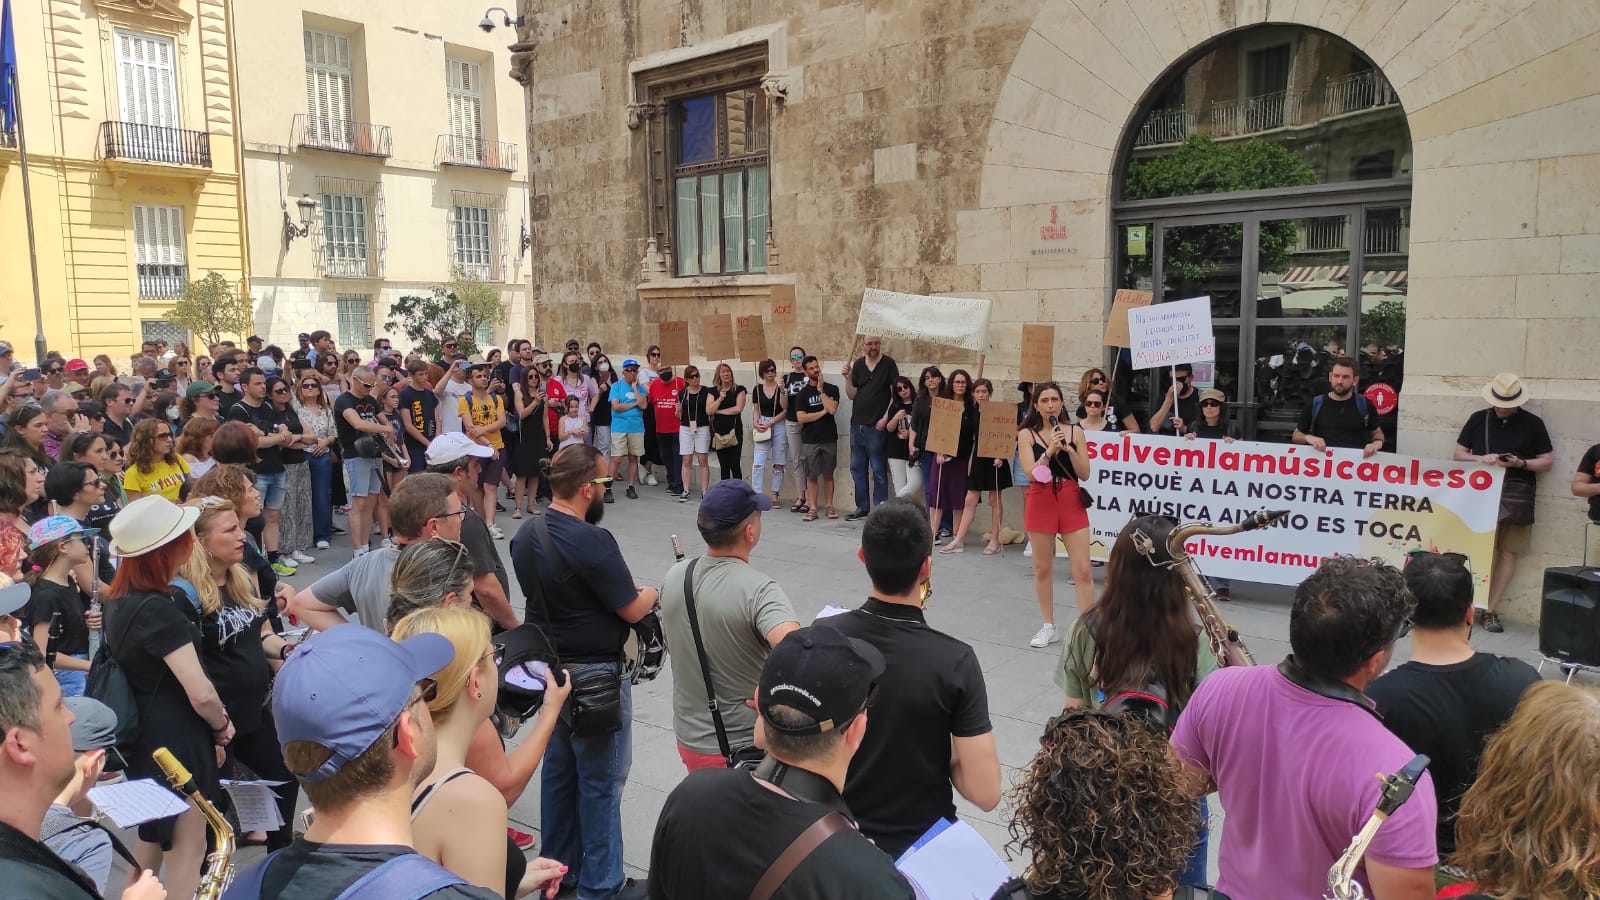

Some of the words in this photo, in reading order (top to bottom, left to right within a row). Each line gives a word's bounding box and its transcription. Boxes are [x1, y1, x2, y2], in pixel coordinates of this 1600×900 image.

[1098, 470, 1183, 491] PERQUÈ
[1189, 477, 1204, 493] A
[1212, 479, 1239, 497] LA
[1248, 482, 1344, 506] NOSTRA
[1354, 490, 1434, 513] TERRA
[1097, 496, 1122, 512] LA
[1128, 495, 1212, 522] MÚSICA
[1317, 516, 1345, 533] ES
[1355, 519, 1422, 542] TOCA
